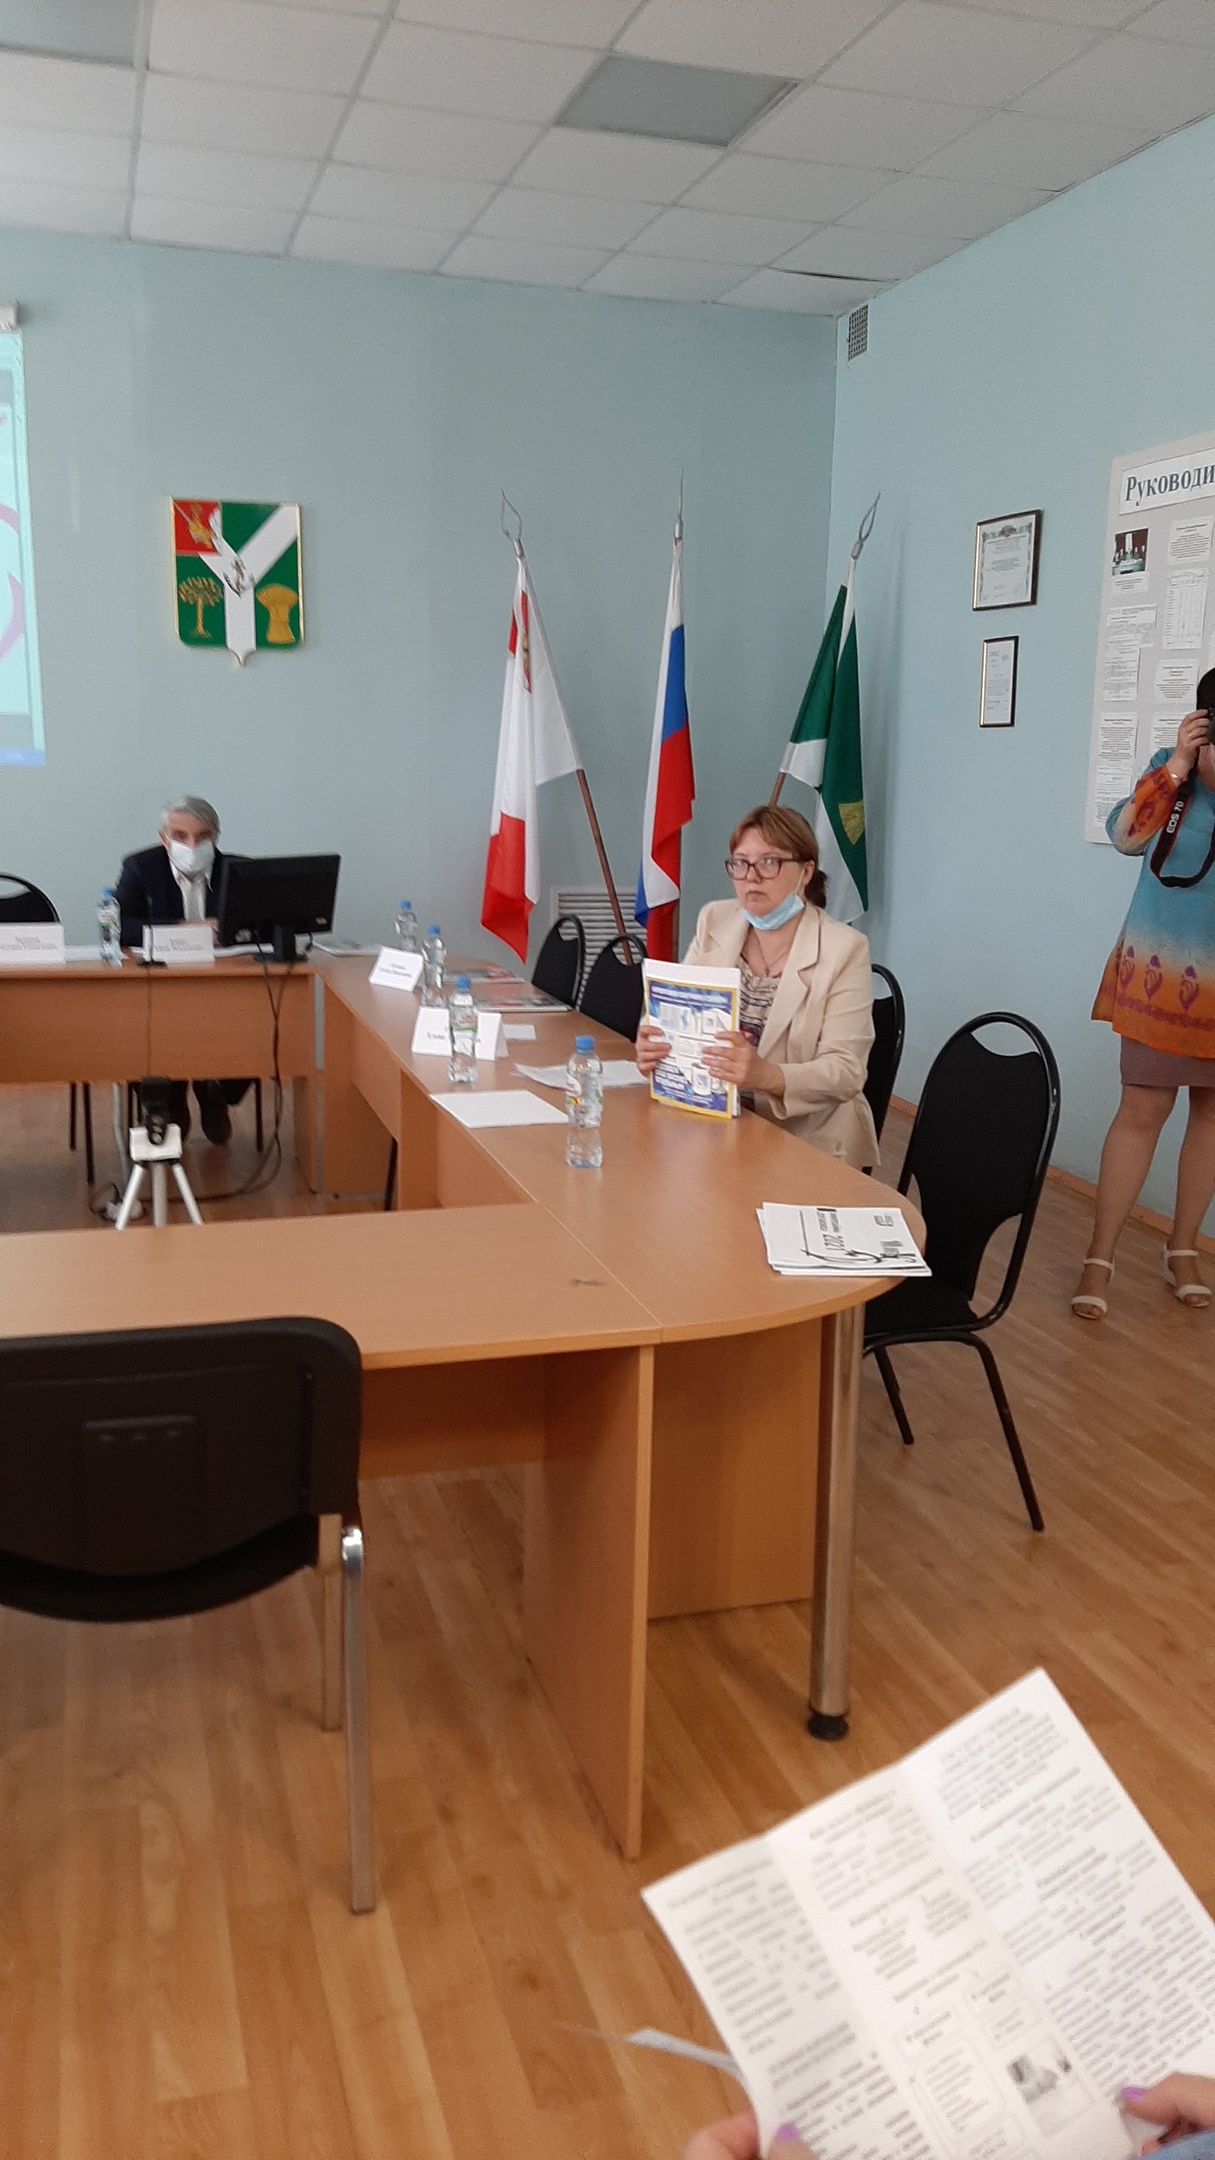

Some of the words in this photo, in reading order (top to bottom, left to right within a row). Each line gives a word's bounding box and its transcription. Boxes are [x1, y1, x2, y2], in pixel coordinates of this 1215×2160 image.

[1126, 464, 1215, 506] Руководи
[1166, 813, 1180, 834] EOS
[823, 1233, 846, 1251] 2021
